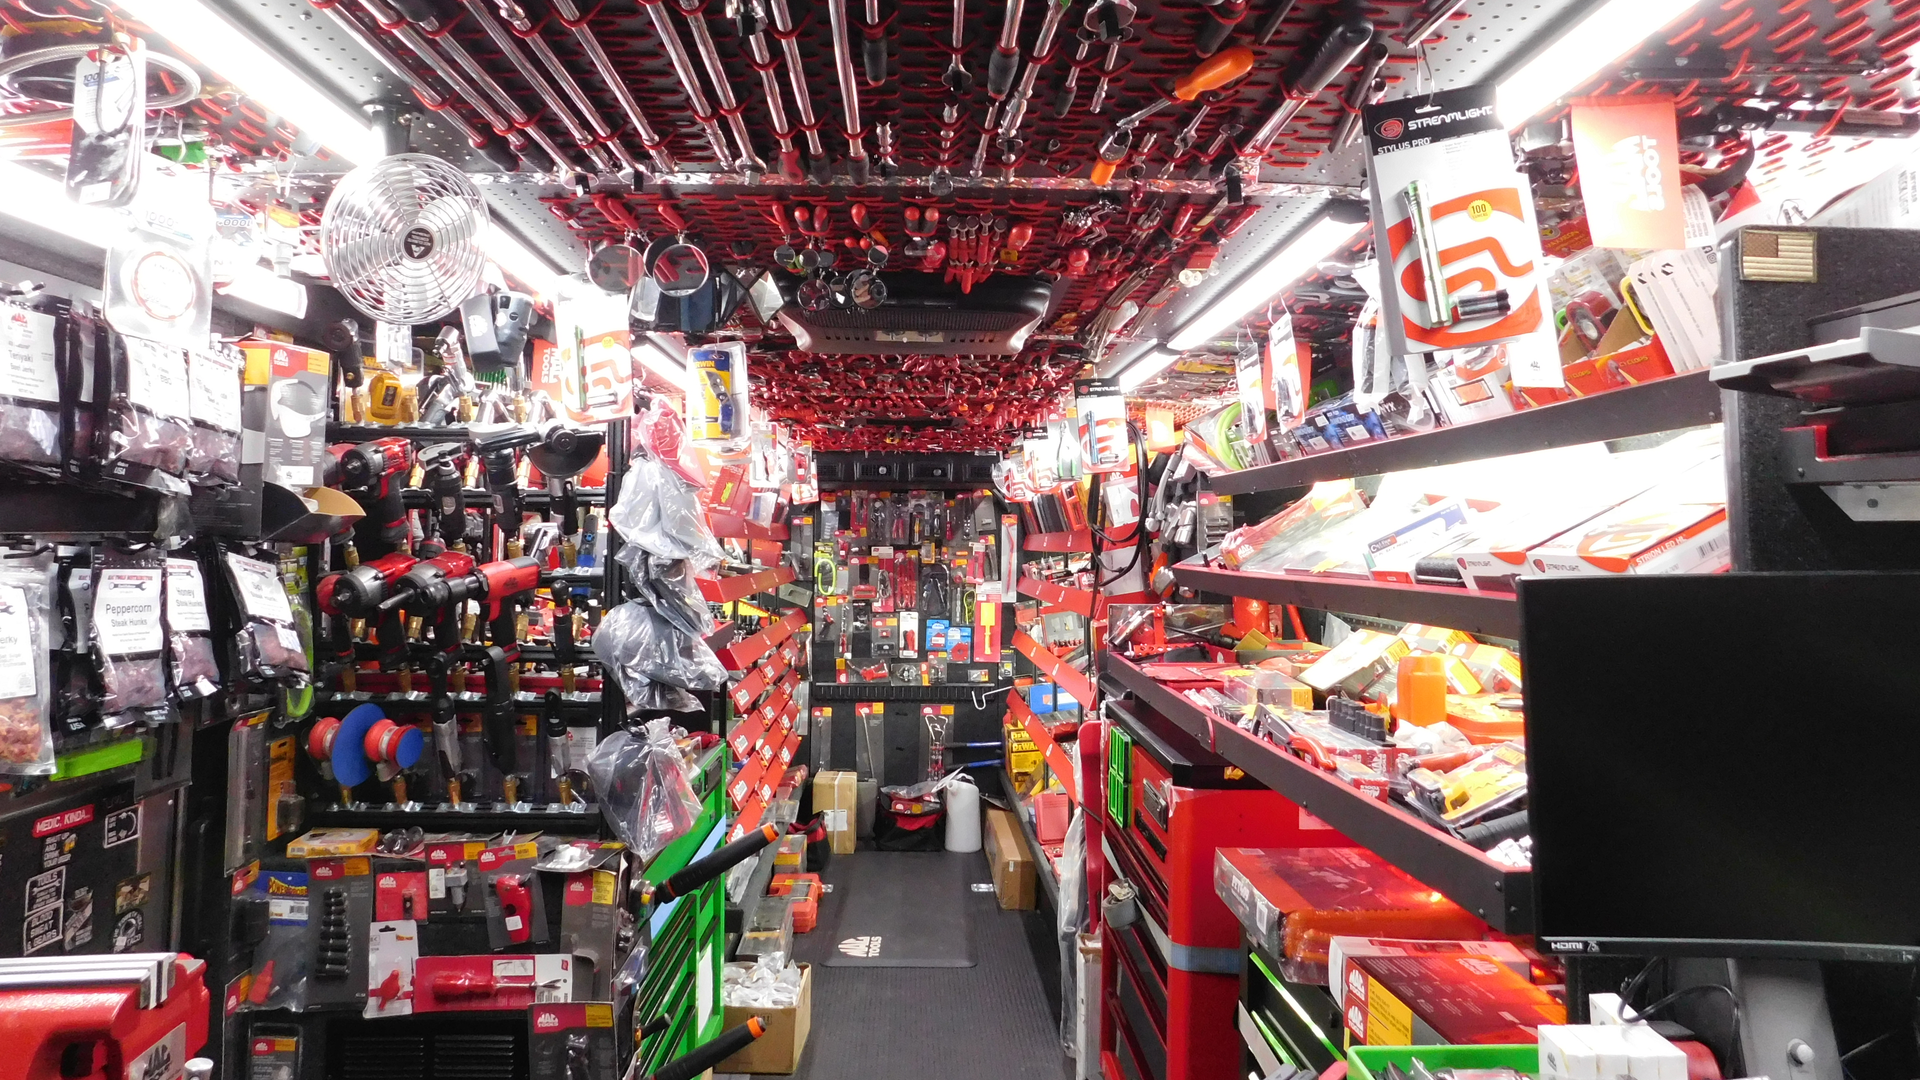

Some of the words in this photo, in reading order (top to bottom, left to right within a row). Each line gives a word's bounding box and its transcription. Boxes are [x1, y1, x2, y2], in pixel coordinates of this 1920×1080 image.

[1407, 105, 1493, 131] STREAMLIGHT
[1377, 140, 1411, 155] STYLUS
[1472, 203, 1487, 214] 100
[541, 348, 551, 384] TOOLS
[1620, 355, 1649, 367] CYCLOPS
[1635, 548, 1661, 566] STRION
[1660, 541, 1676, 555] LED
[105, 603, 152, 616] Peppercorn
[111, 619, 128, 627] Steak
[129, 618, 148, 627] Hunks
[36, 816, 62, 833] MEDIC,
[38, 872, 58, 886] TOOLS
[30, 920, 54, 939] SWEAT
[838, 936, 870, 957] MAC
[868, 936, 882, 957] TOOLS
[1551, 942, 1583, 950] HDMI
